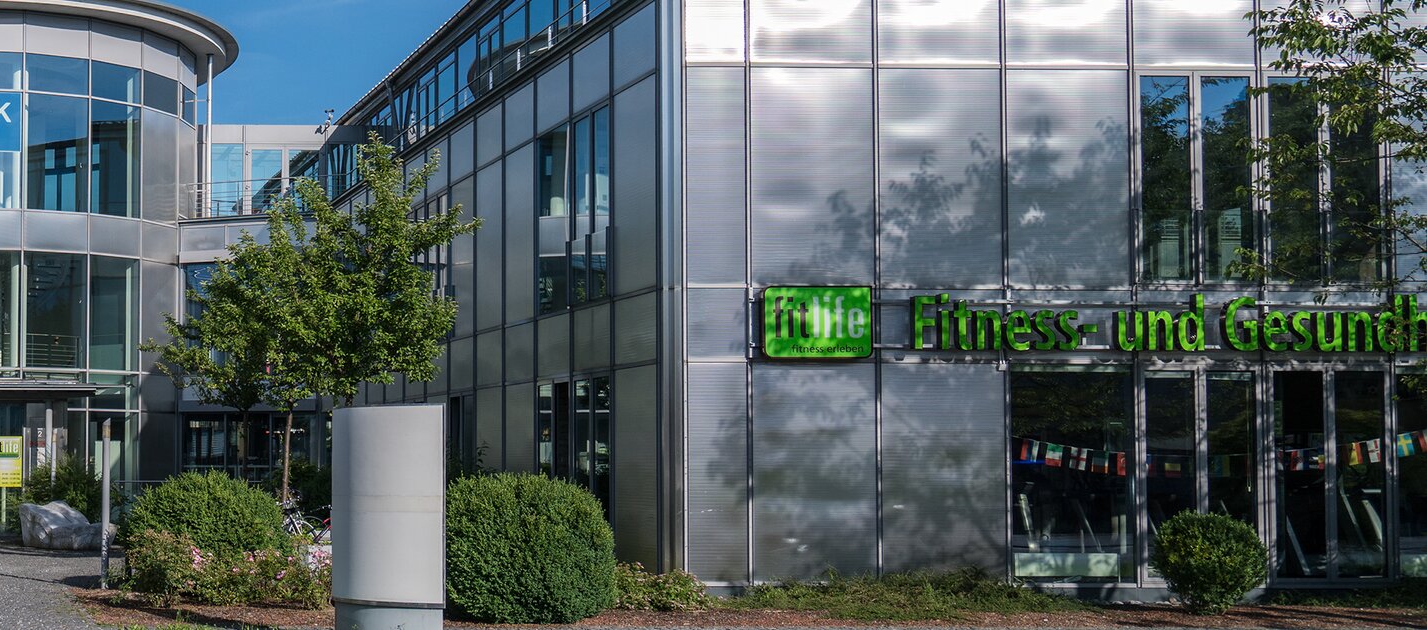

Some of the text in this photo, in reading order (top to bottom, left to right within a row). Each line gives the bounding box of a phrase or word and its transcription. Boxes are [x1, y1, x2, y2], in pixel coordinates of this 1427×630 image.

[773, 295, 864, 339] fitlife
[911, 292, 1099, 351] Fitness-
[1114, 292, 1206, 352] und
[791, 344, 864, 353] fitness erleben
[37, 430, 43, 438] 2
